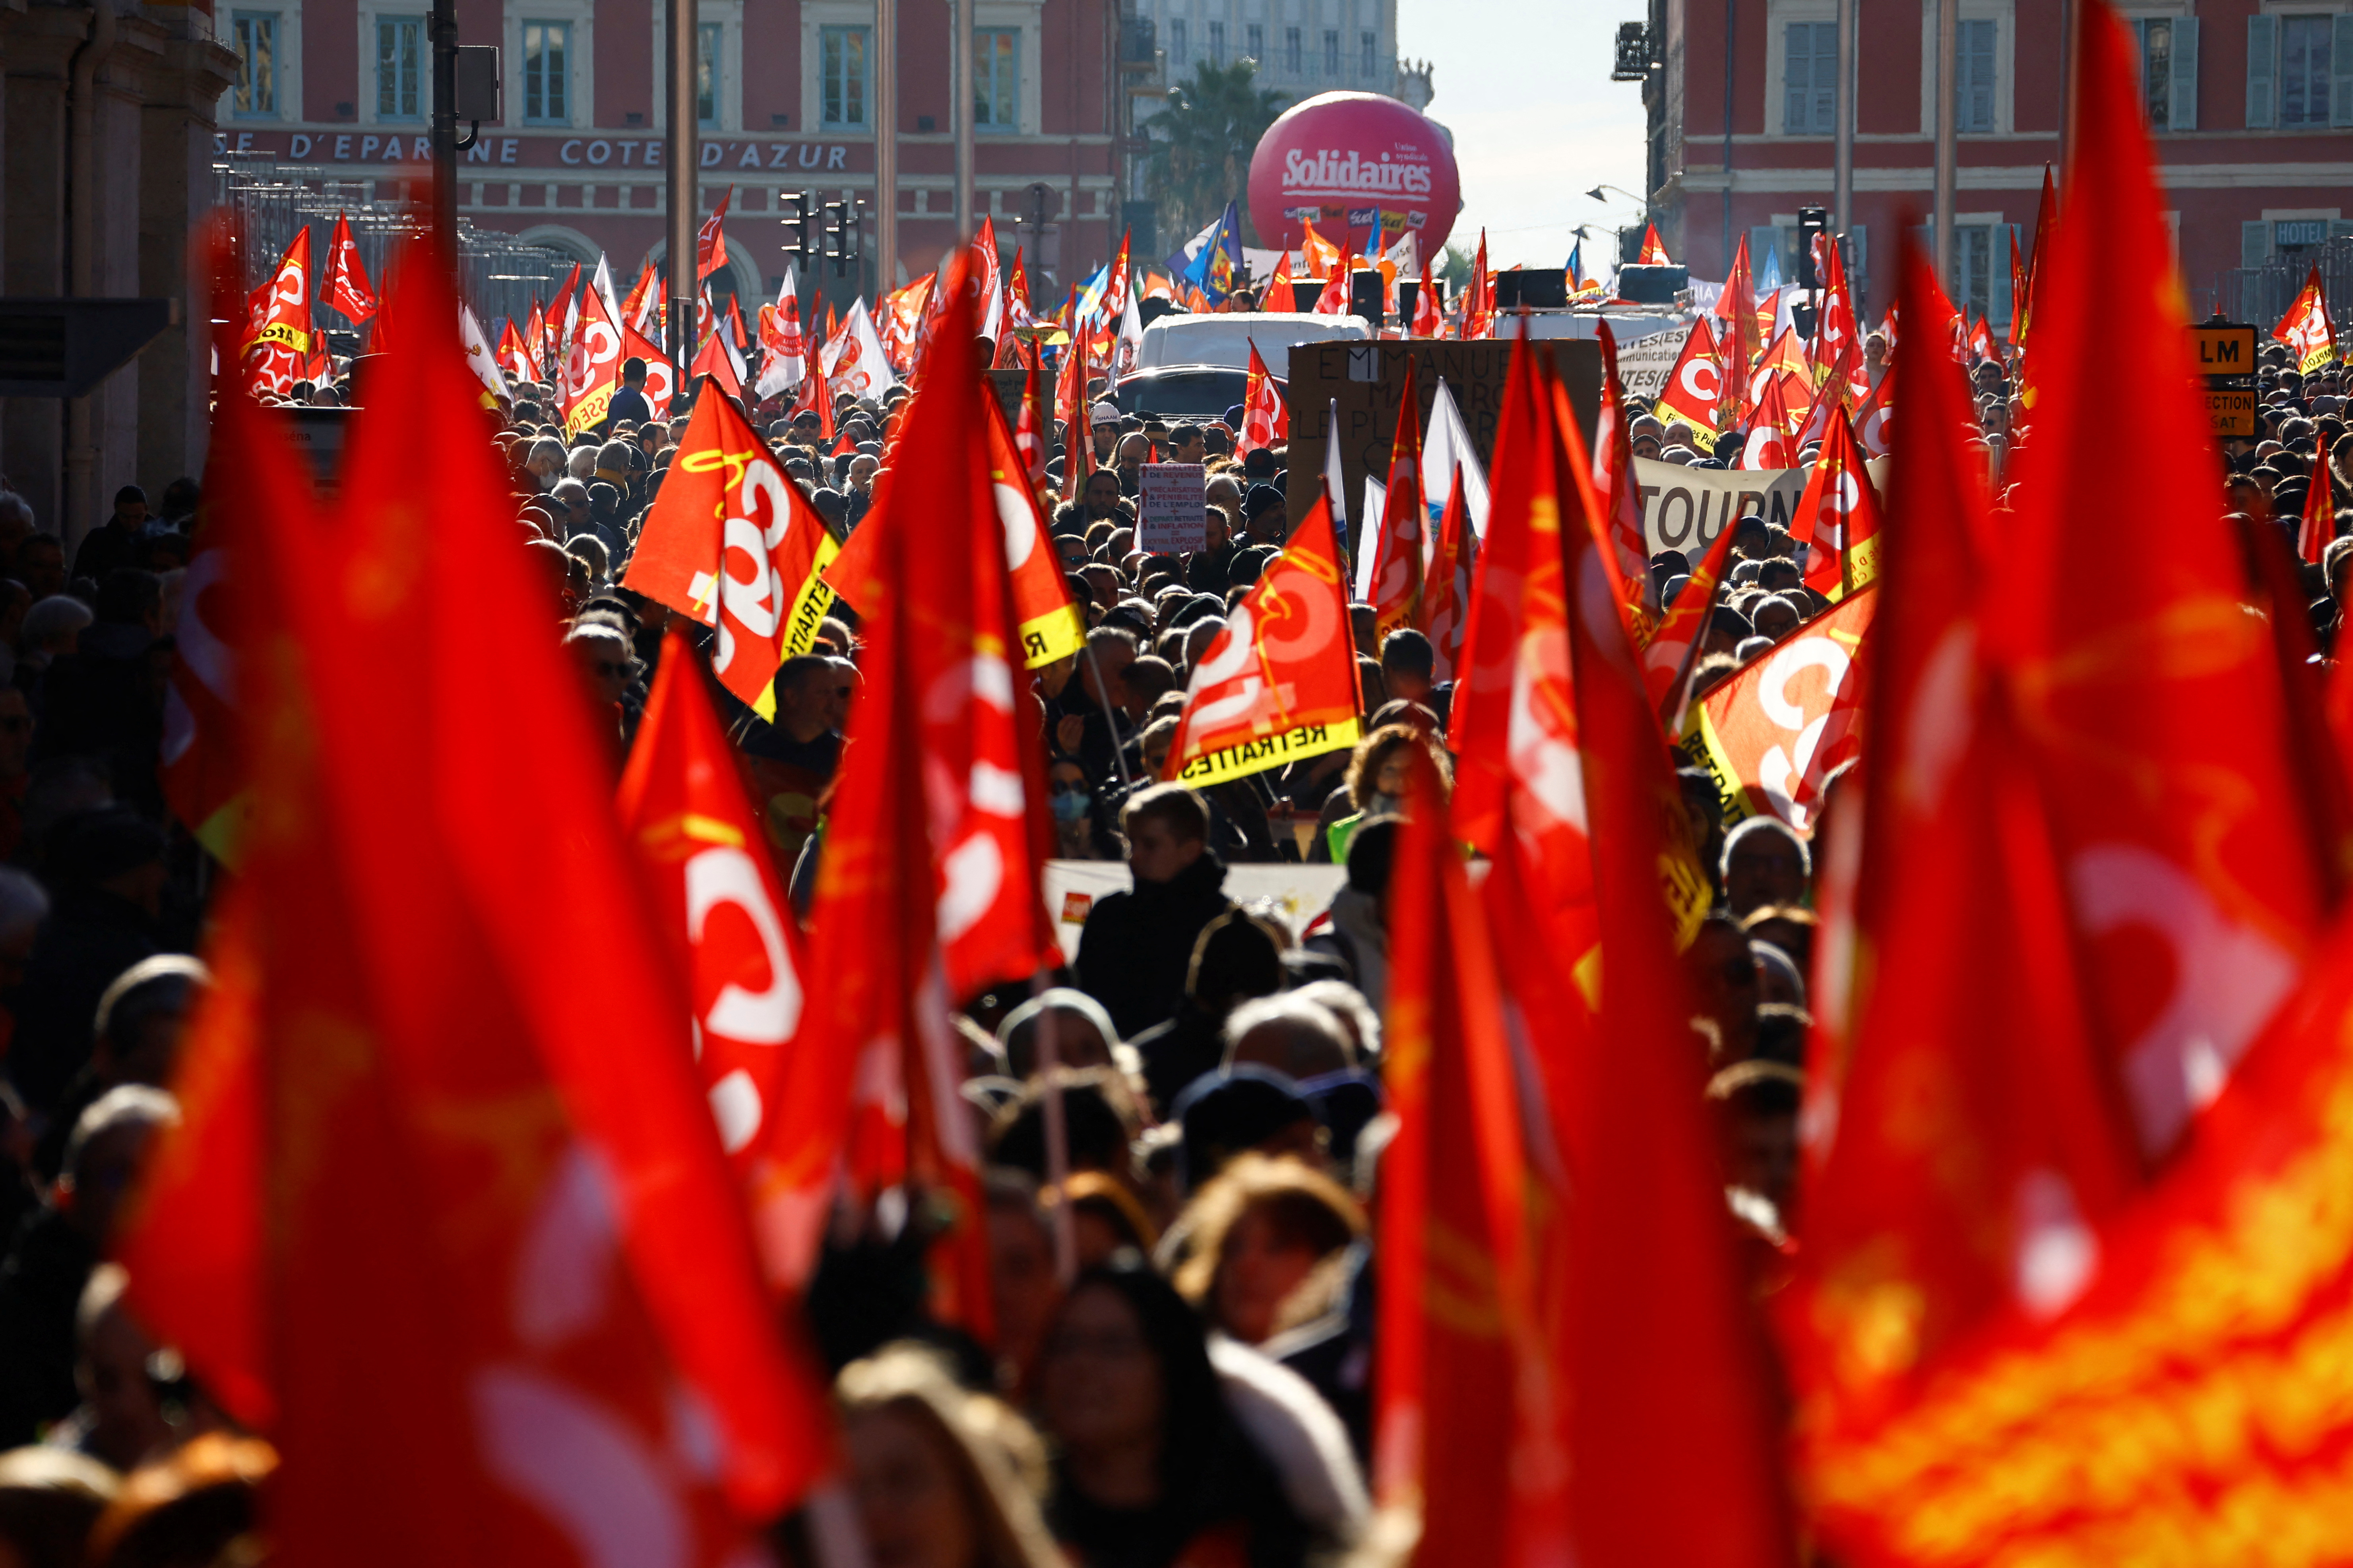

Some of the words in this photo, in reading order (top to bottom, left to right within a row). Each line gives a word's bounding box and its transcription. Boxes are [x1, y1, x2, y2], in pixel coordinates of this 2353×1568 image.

[290, 134, 519, 163] D'EPARNE
[560, 139, 663, 166] COTE
[700, 142, 847, 170] D'AZUR
[1282, 149, 1431, 193] Solidaires
[2279, 223, 2324, 243] HOTEL
[1320, 347, 1511, 379] EMMANUE
[2205, 396, 2252, 410] ECTION
[1682, 730, 1747, 828] RETRAIT
